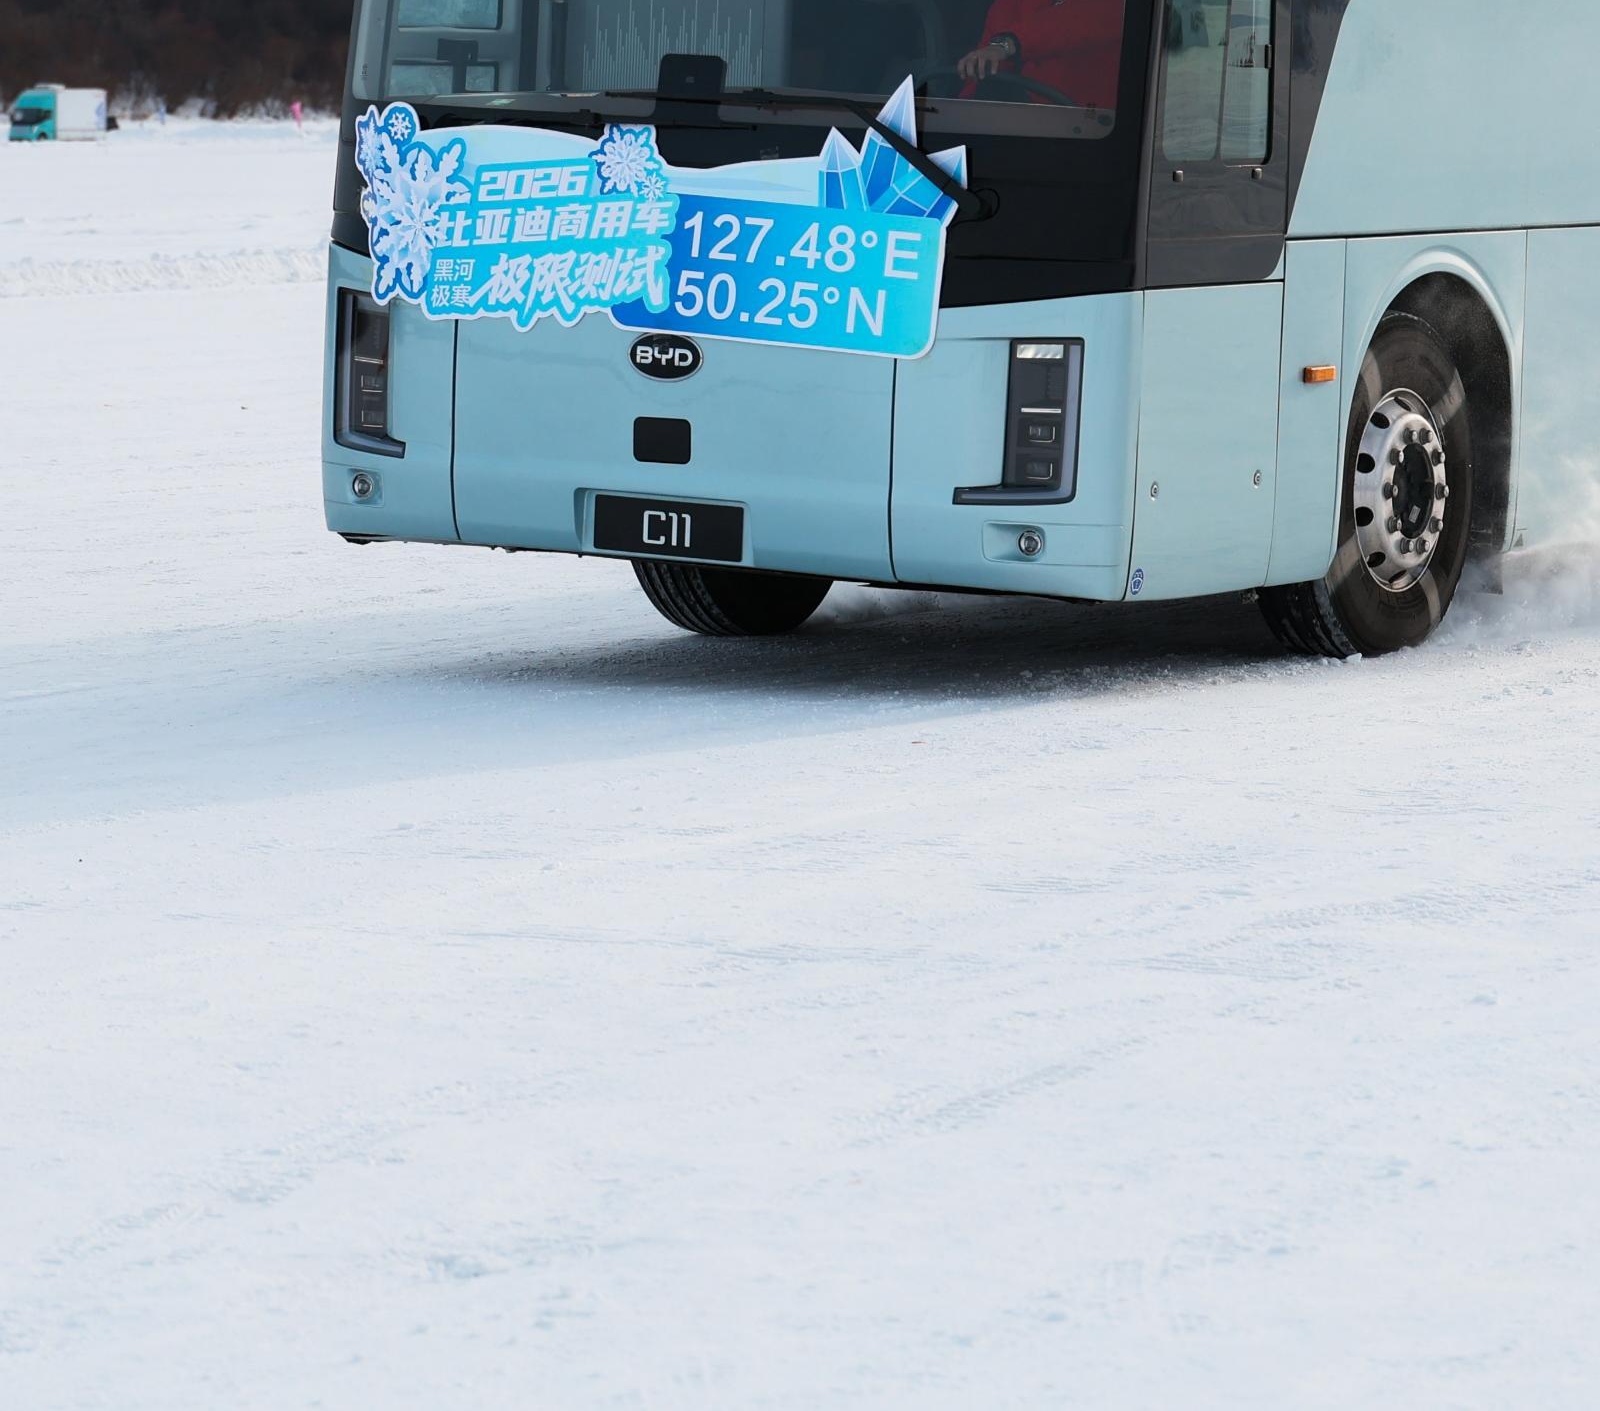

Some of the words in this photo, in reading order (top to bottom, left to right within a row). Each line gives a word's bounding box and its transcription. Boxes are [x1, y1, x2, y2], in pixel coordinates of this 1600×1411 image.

[478, 165, 590, 202] 2026
[436, 201, 673, 248] 比亚迪商用车
[683, 210, 922, 280] 127.48°E
[433, 258, 476, 282] 黑河
[469, 245, 666, 320] 极限测试
[431, 284, 472, 308] 极寒
[674, 269, 886, 336] 50.25°N
[636, 345, 693, 367] BYD
[643, 510, 692, 548] C11
